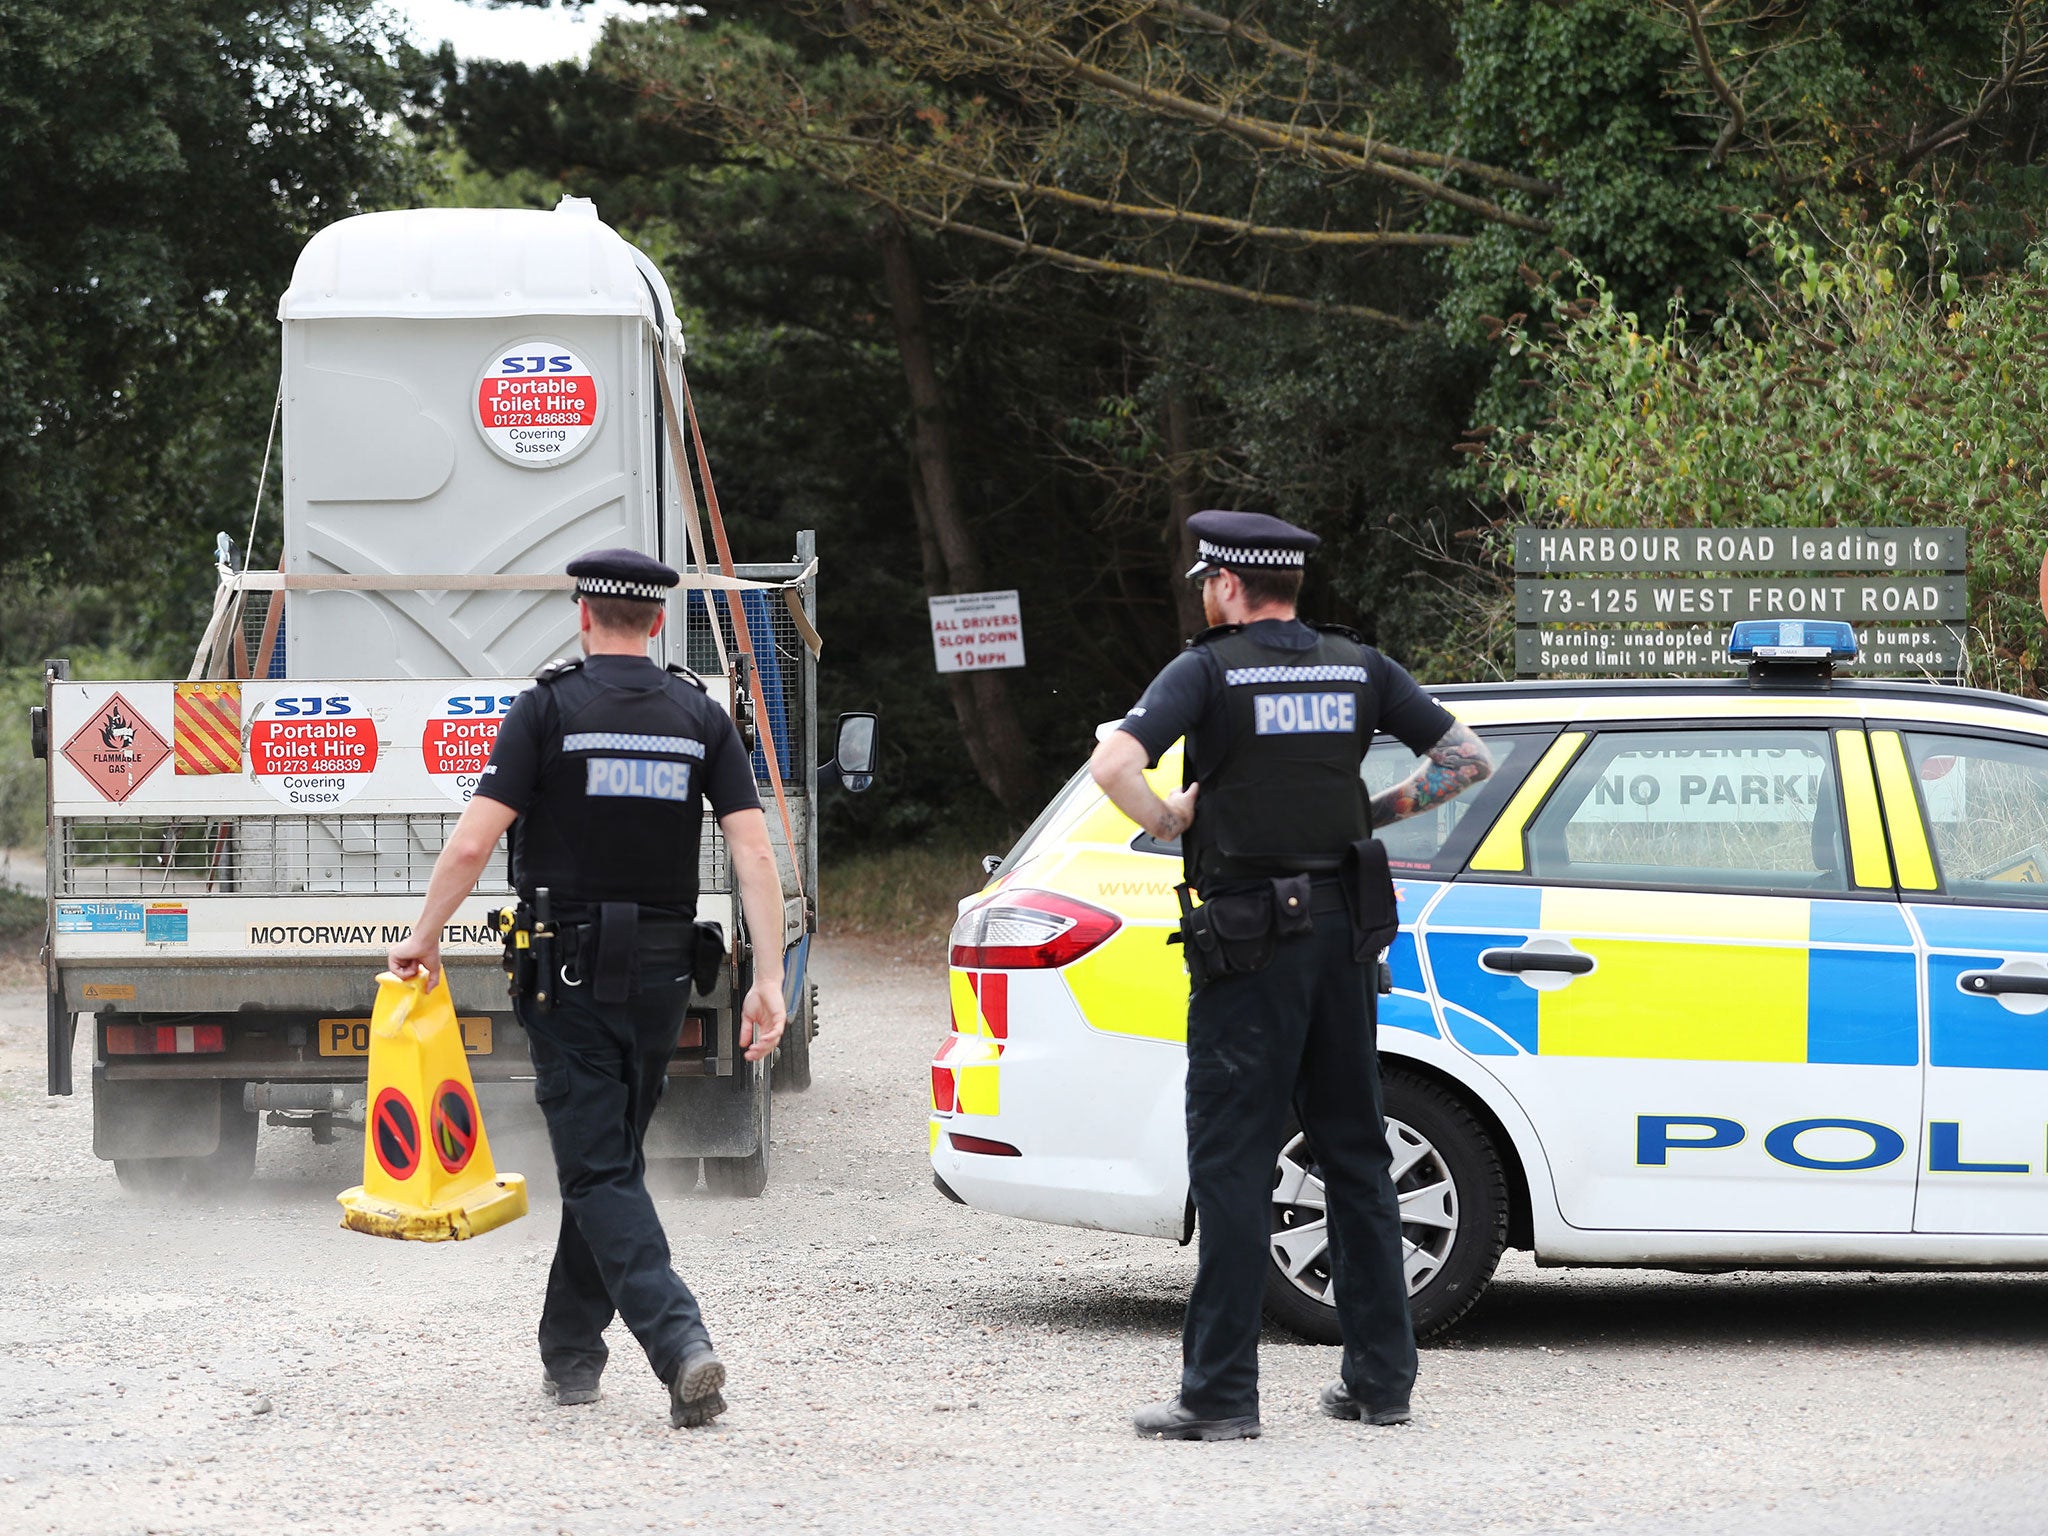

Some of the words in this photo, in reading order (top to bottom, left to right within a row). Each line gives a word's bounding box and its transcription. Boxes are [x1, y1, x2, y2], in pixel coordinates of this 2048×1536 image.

[502, 356, 572, 373] SJS
[497, 378, 578, 394] Portable
[489, 396, 541, 412] Toilet
[547, 395, 586, 411] Hire
[494, 414, 532, 425] 01273
[535, 412, 581, 424] 486839
[509, 428, 566, 441] Covering
[515, 442, 561, 453] Sussex
[1540, 537, 1680, 562] HARBOUR
[1696, 536, 1774, 561] ROAD
[1792, 536, 1897, 566] leading
[1913, 536, 1939, 560] to
[1541, 588, 1638, 613] 73-125
[1653, 588, 1733, 612] WEST
[1749, 588, 1845, 612] FRONT
[1861, 587, 1939, 611] ROAD
[936, 620, 957, 630] ALL
[962, 614, 1018, 629] DRIVERS
[940, 634, 975, 646] SLOW
[979, 631, 1017, 643] DOWN
[1540, 631, 1616, 649] Warning:
[1624, 631, 1712, 649] unadopted
[1877, 630, 1937, 648] bumps.
[955, 650, 974, 666] 10
[978, 653, 1006, 664] MPH
[1540, 651, 1588, 668] Speed
[1596, 651, 1631, 665] limit
[1639, 651, 1656, 665] 10
[1664, 651, 1696, 665] MPH
[1874, 653, 1892, 664] on
[1899, 650, 1943, 664] roads
[275, 697, 351, 716] SJS
[1257, 694, 1354, 732] POLICE
[270, 722, 357, 739] Portable
[261, 741, 317, 758] Toilet
[324, 740, 366, 757] Hire
[434, 740, 490, 757] Toilet
[109, 764, 126, 773] GAS
[267, 760, 308, 773] 01273
[311, 759, 361, 772] 486839
[439, 759, 481, 772] 01273
[283, 776, 345, 789] Covering
[590, 759, 688, 801] POLICE
[290, 791, 340, 803] Sussex
[1595, 775, 1660, 805] NO
[87, 904, 117, 915] Slim
[116, 910, 140, 920] Jim
[251, 926, 376, 944] MOTORWAY
[382, 926, 506, 944] MATENAN
[1635, 1113, 2048, 1175] POL
